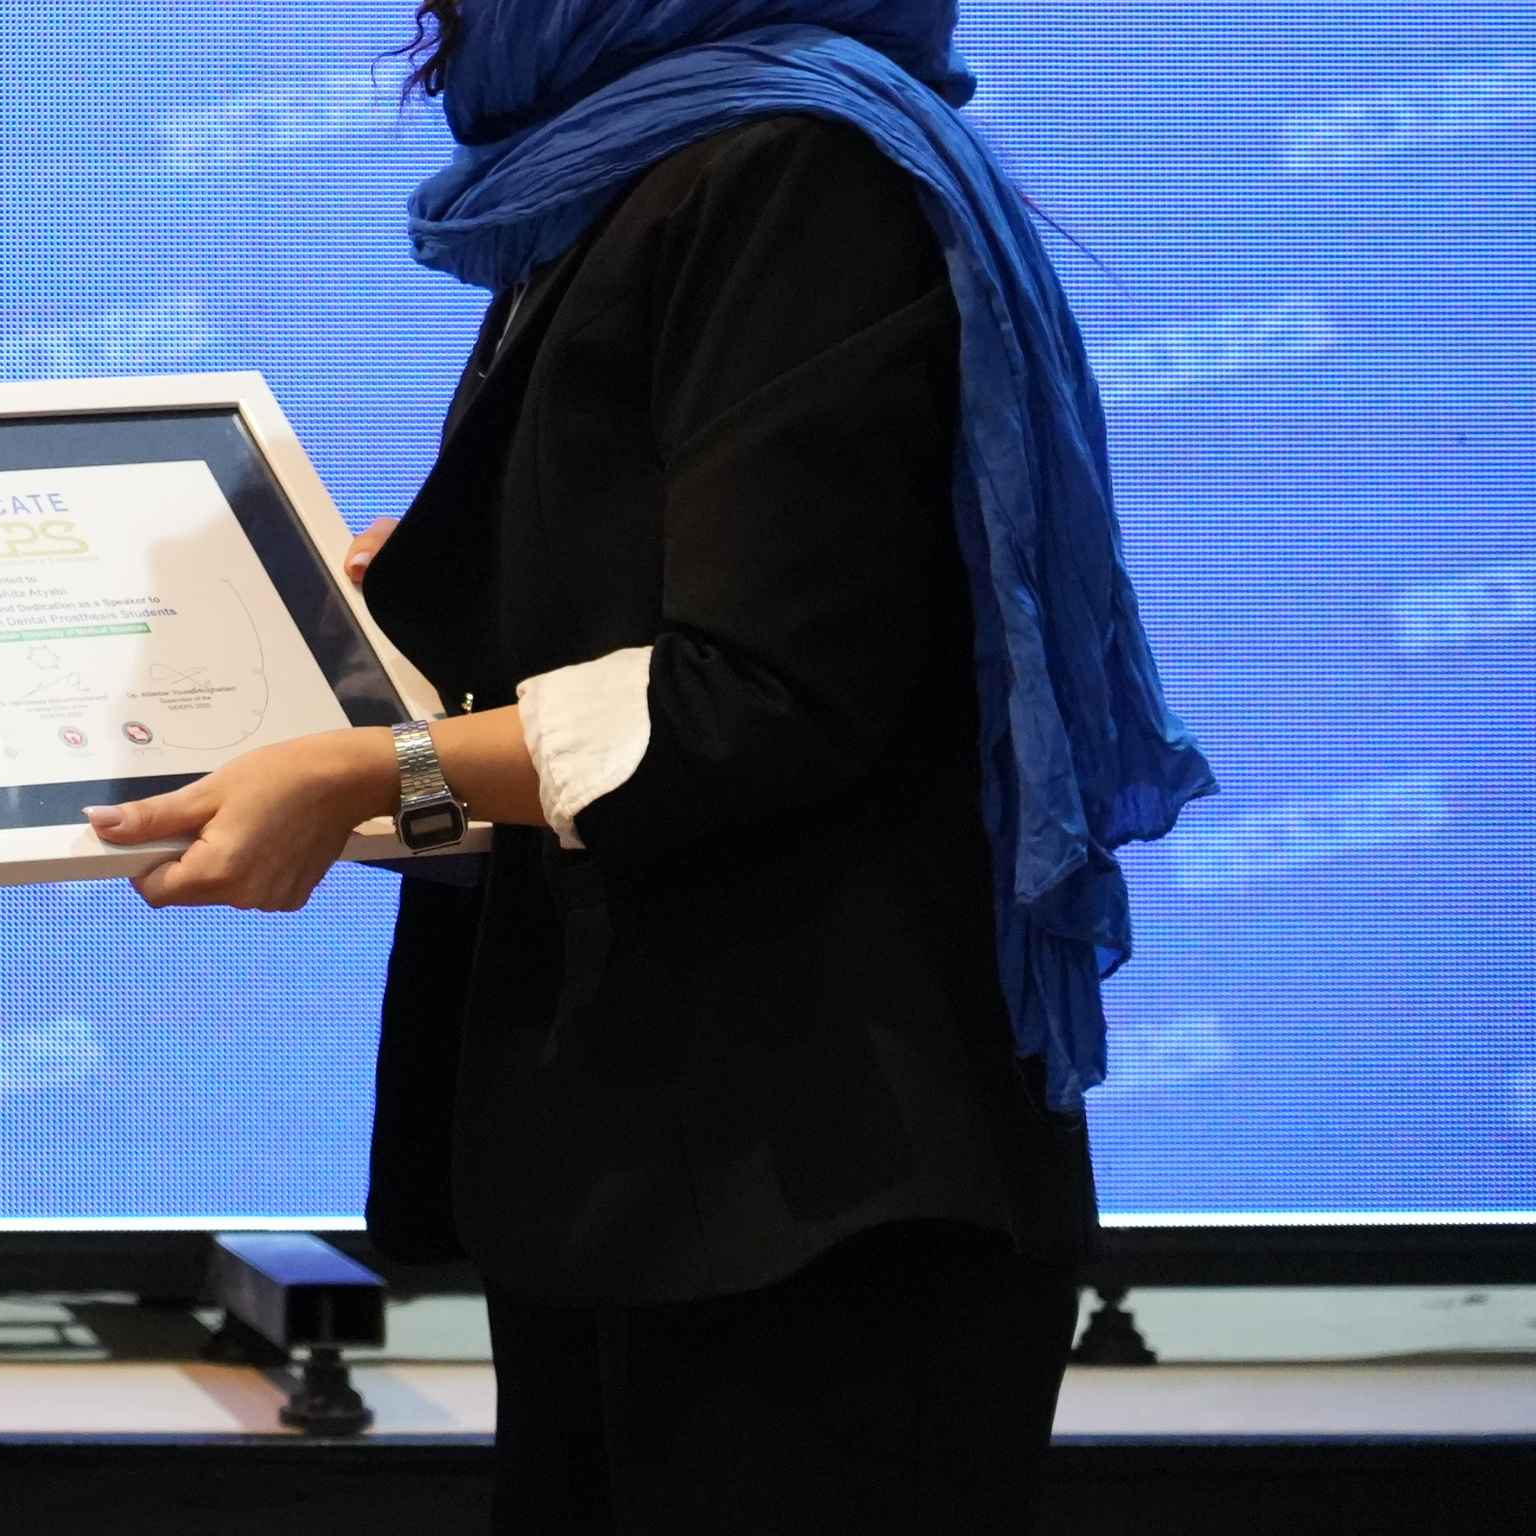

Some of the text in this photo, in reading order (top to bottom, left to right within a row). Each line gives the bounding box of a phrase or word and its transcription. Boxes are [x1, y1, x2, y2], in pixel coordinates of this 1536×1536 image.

[148, 595, 161, 604] to
[5, 613, 48, 627] Dental
[119, 606, 179, 620] Students
